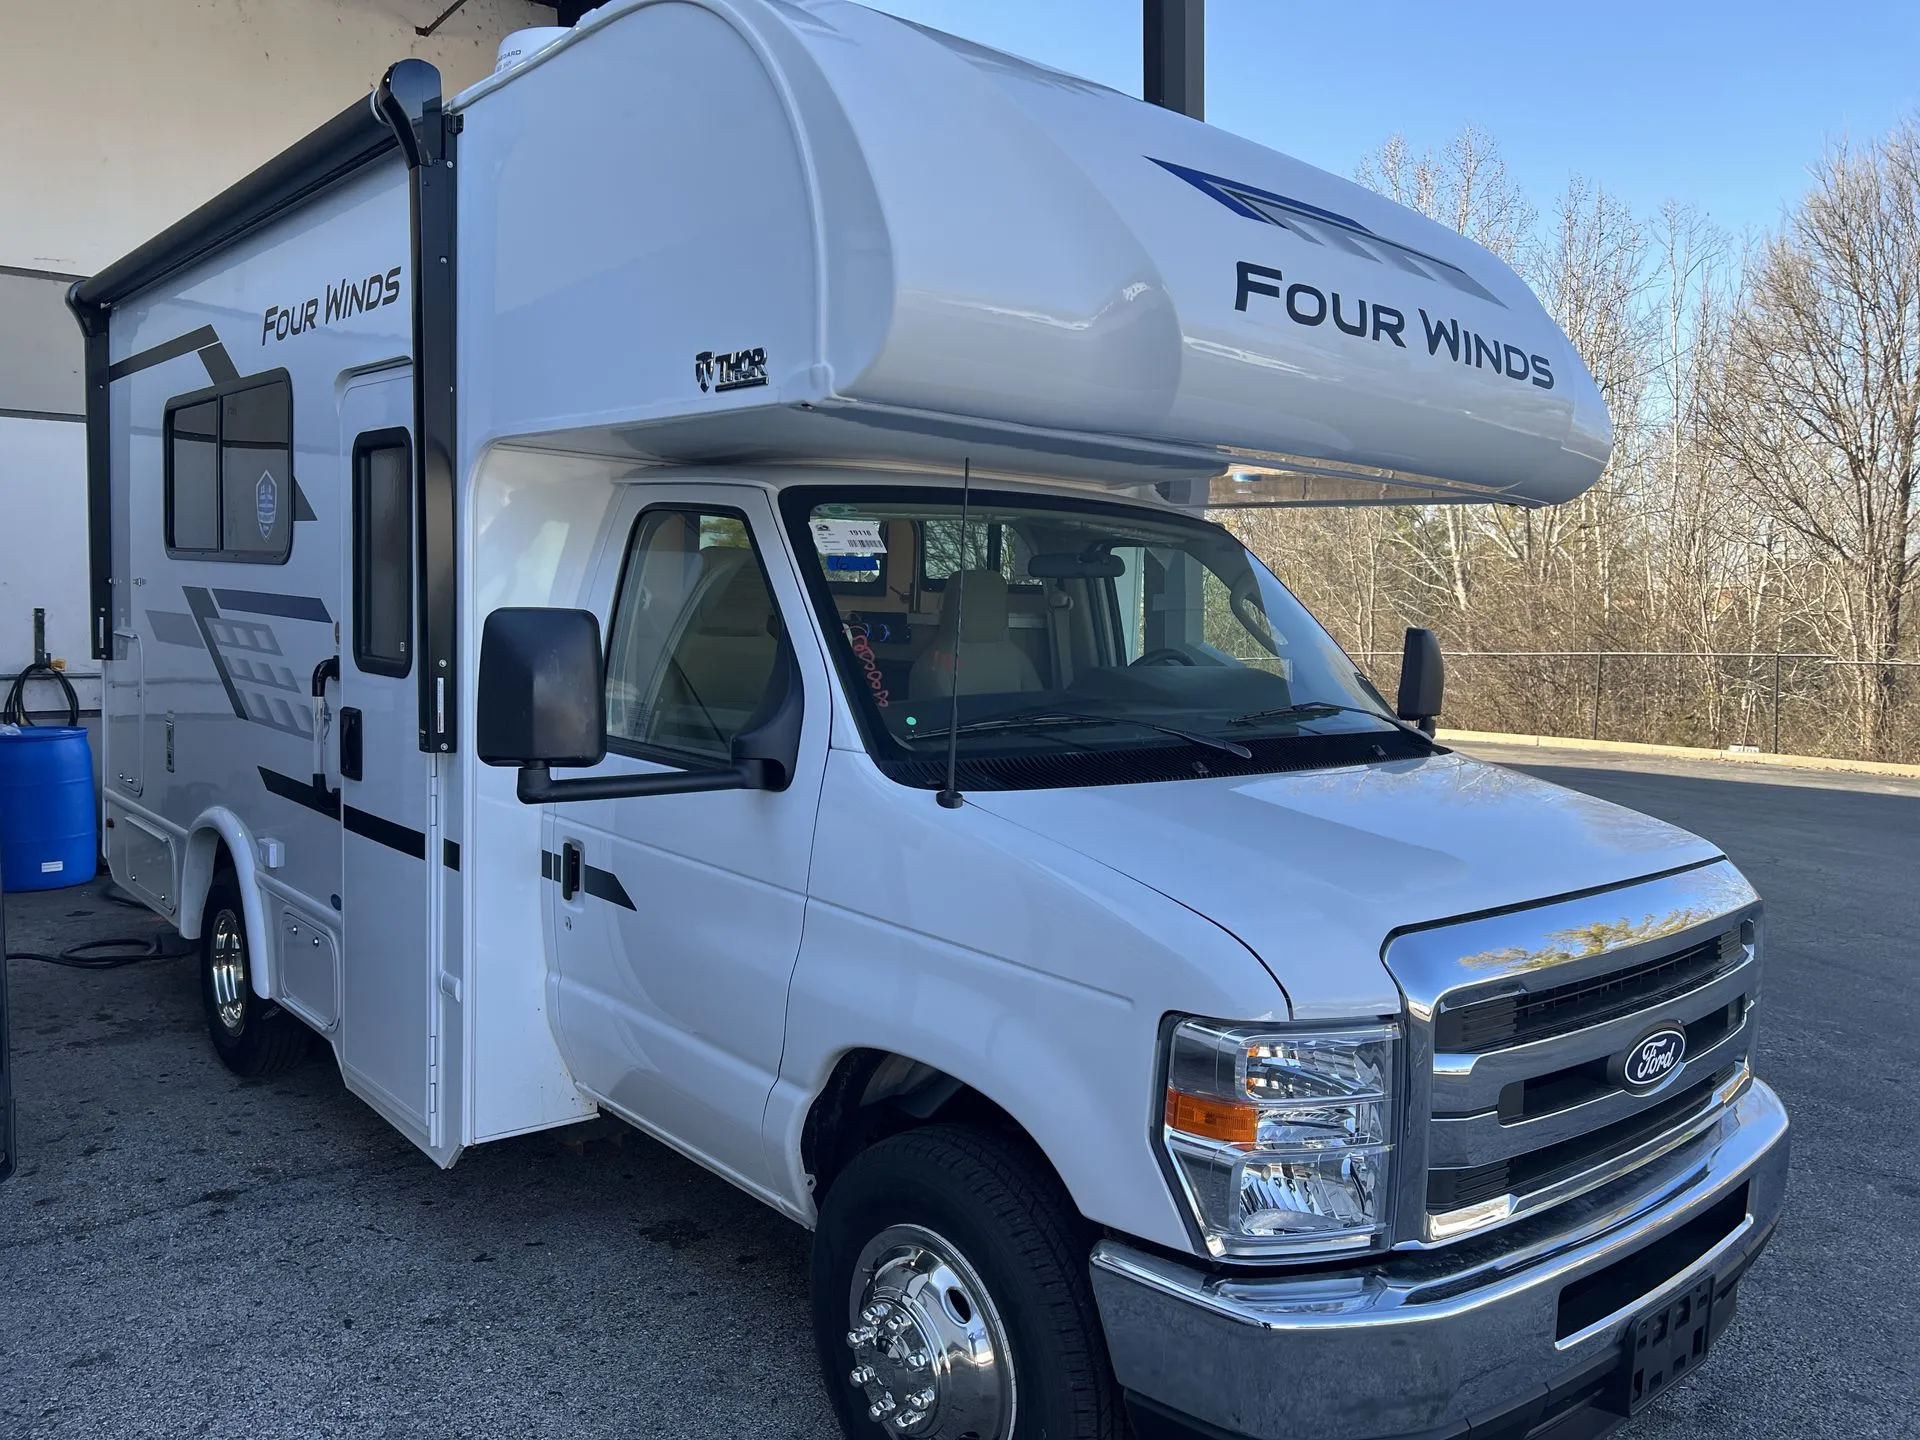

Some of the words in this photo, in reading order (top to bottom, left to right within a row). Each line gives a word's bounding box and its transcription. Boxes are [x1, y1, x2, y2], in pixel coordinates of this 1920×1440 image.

[262, 298, 319, 346] FOUR
[325, 266, 402, 325] WINDS
[1235, 261, 1407, 348] FOUR
[1418, 308, 1555, 390] WINDS
[715, 347, 769, 383] THOR
[1637, 1038, 1676, 1079] Ford
